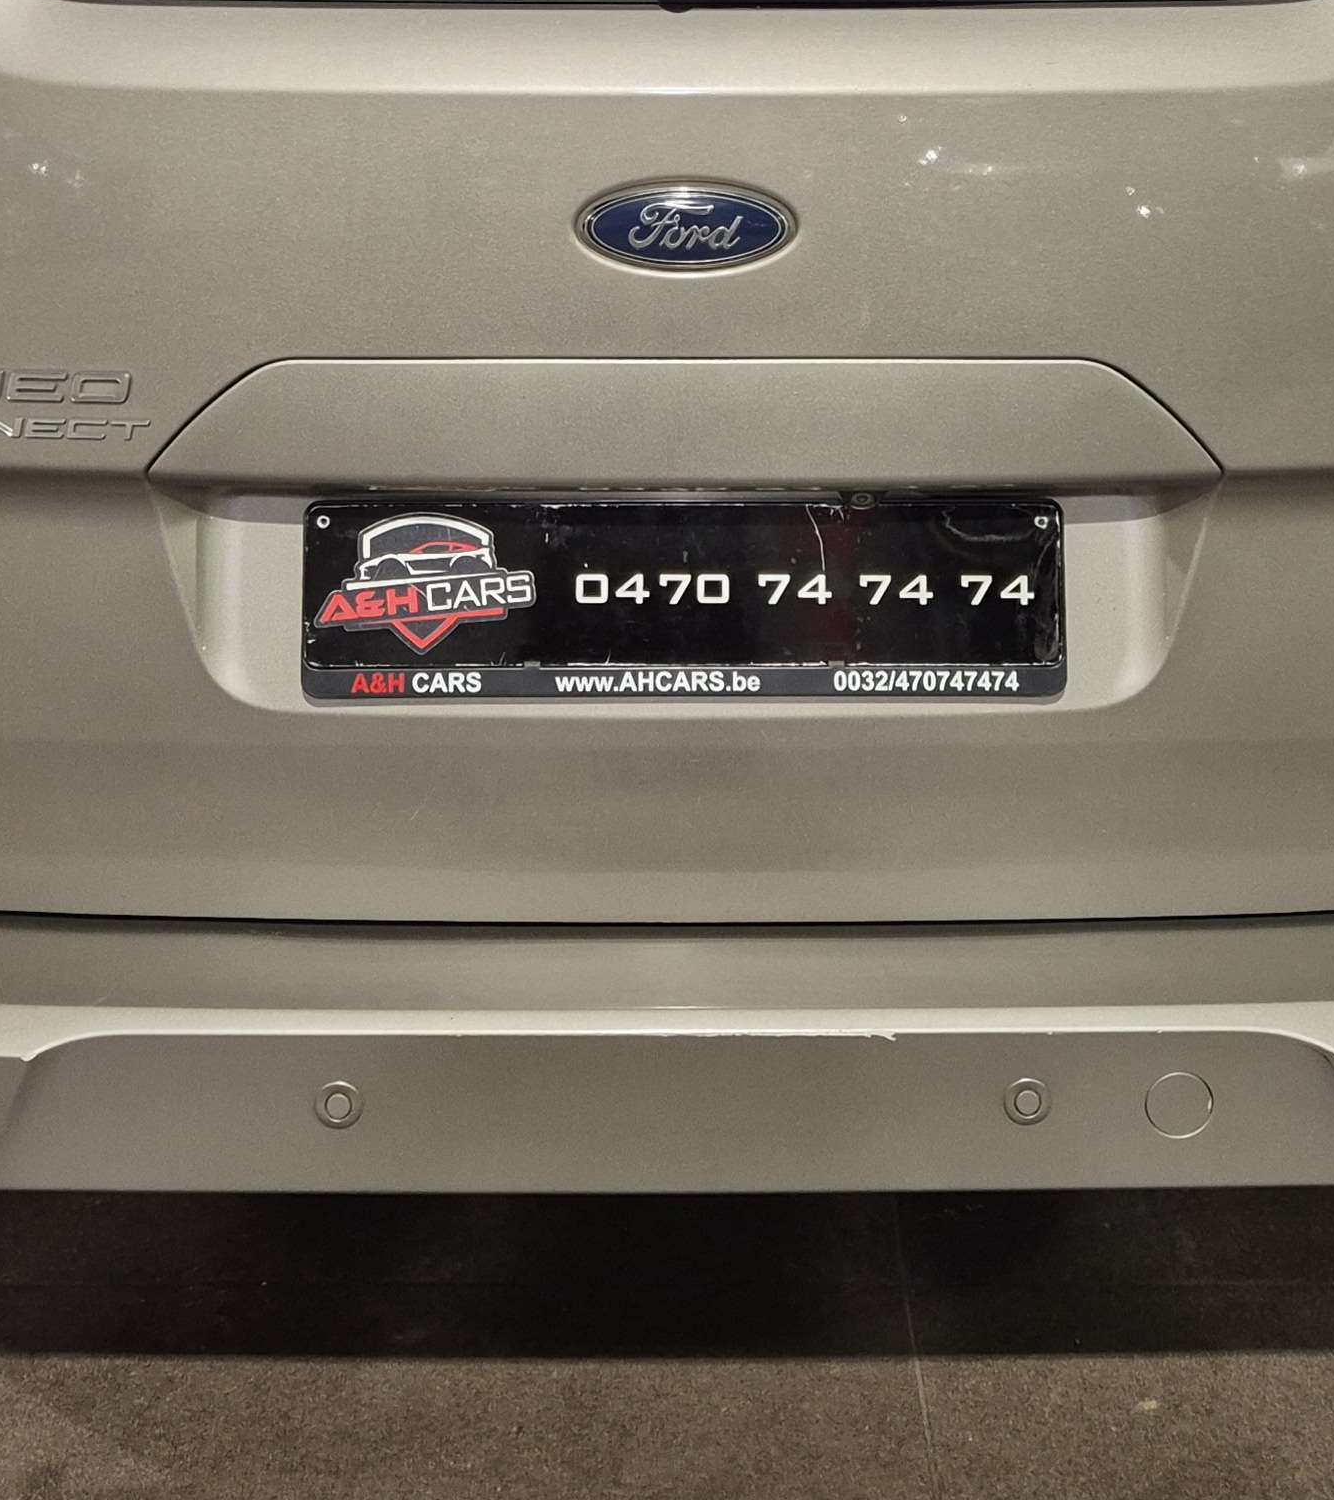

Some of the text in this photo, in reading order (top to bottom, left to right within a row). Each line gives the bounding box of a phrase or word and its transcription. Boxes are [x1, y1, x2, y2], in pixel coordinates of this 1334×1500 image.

[627, 200, 744, 250] Ford
[319, 574, 532, 624] A&H CARS
[574, 573, 1035, 606] 0470 74 74 74
[350, 672, 482, 694] A&H CARS
[555, 670, 761, 693] www.AHCARS.be
[833, 670, 1020, 693] 0032/470747474
